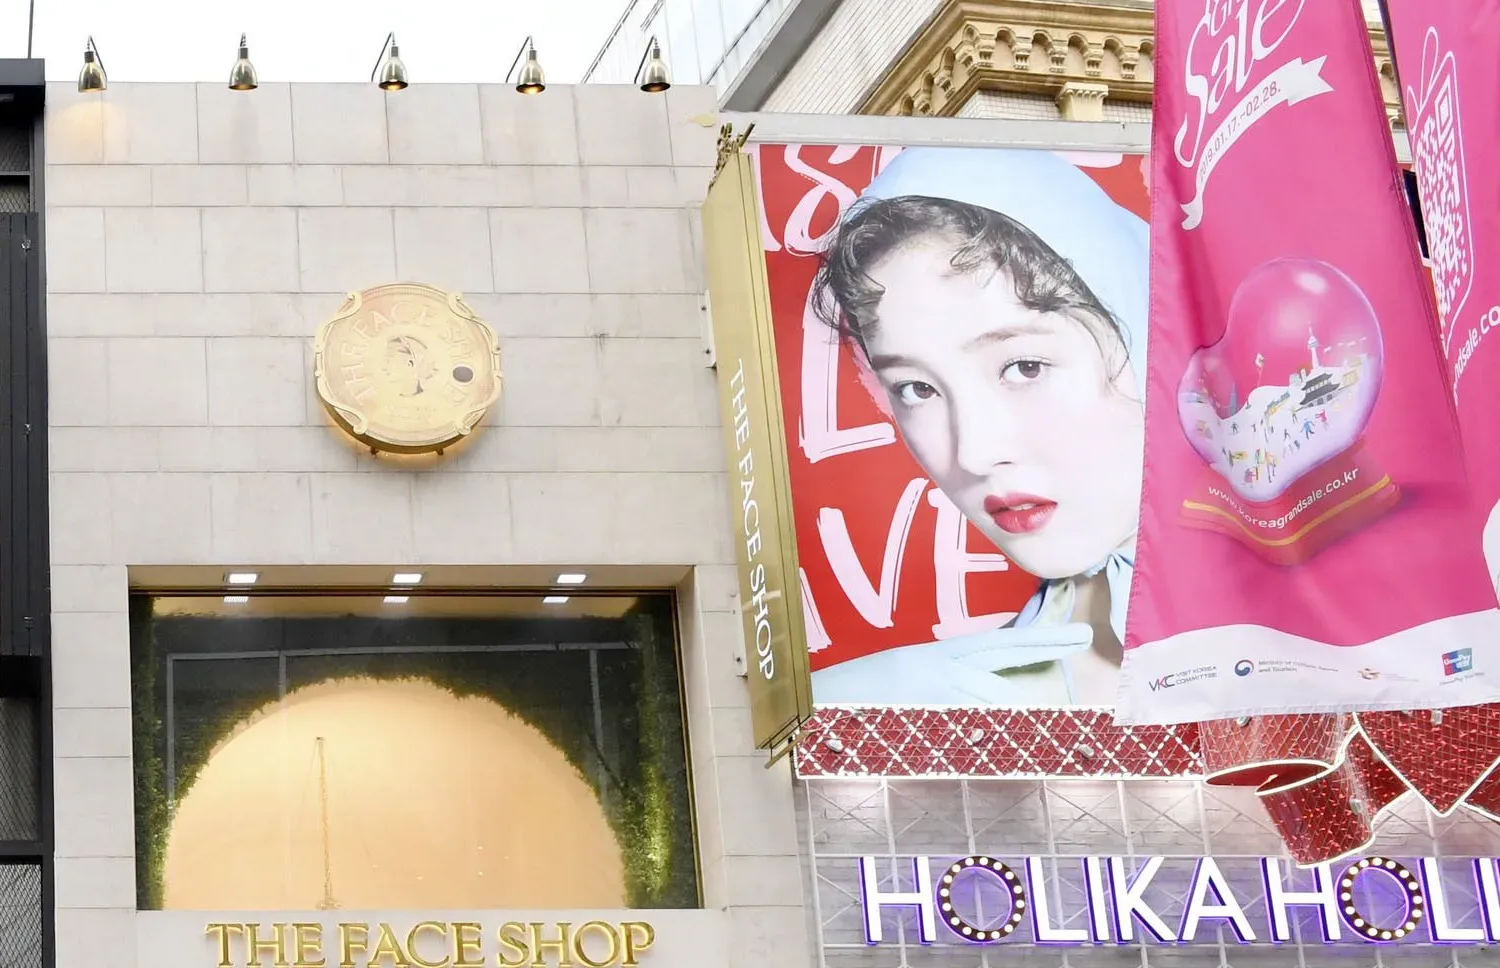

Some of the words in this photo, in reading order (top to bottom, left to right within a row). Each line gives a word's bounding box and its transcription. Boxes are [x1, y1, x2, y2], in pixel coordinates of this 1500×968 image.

[728, 359, 750, 450] THE
[738, 452, 761, 561] FACE
[749, 566, 773, 680] SHOP
[206, 923, 325, 968] THE
[340, 921, 485, 968] FACE
[497, 920, 655, 968] SHOP
[861, 856, 1255, 944] HOLIKA
